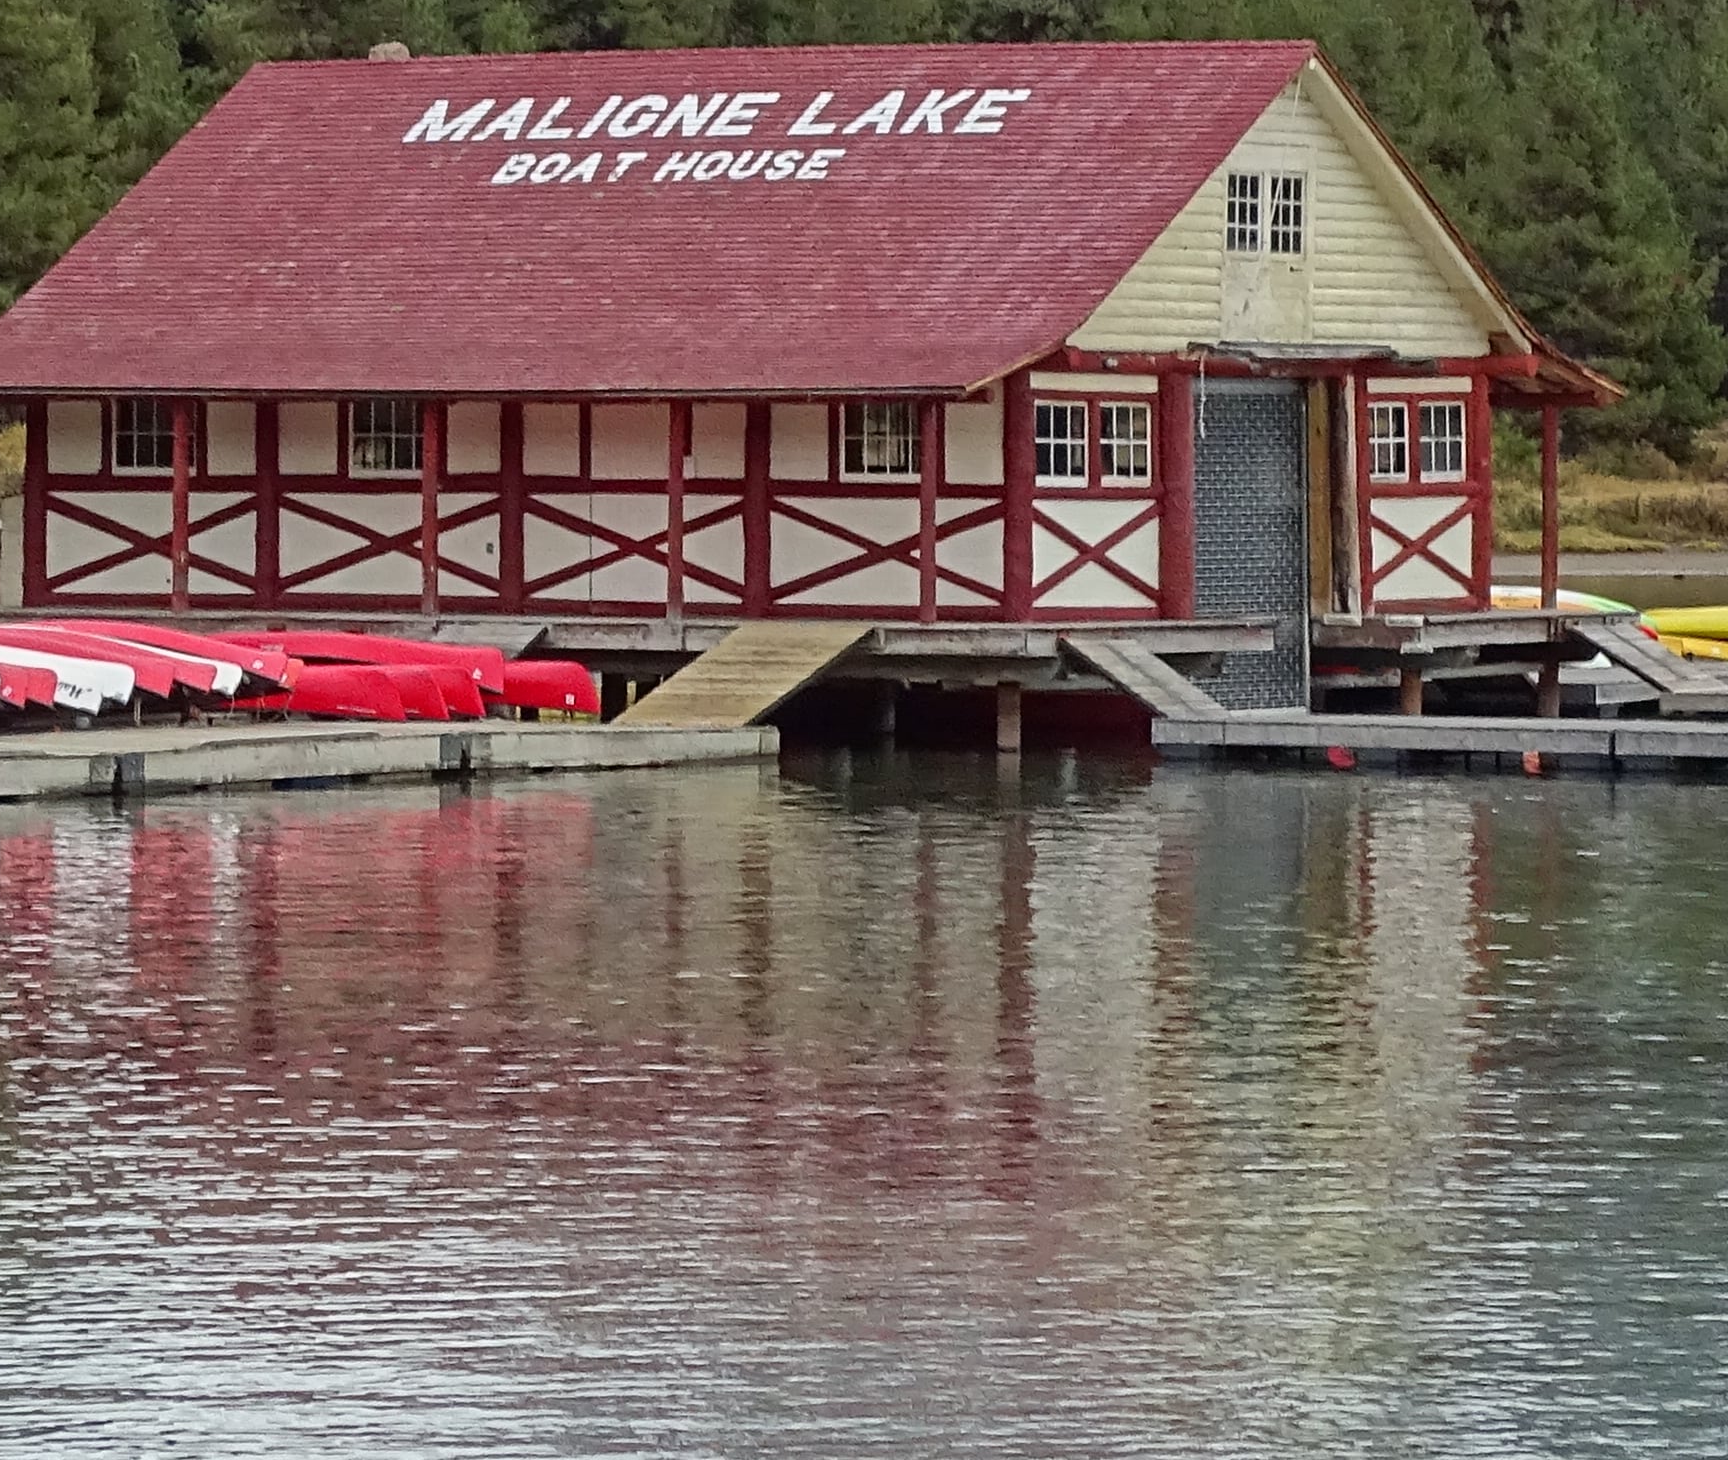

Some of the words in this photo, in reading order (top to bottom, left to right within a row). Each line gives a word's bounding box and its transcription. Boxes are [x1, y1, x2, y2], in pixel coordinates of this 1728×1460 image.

[401, 93, 781, 143] MALIGNE
[787, 88, 1032, 136] LAKE
[490, 151, 648, 184] BOAT
[652, 148, 847, 183] HOUSE
